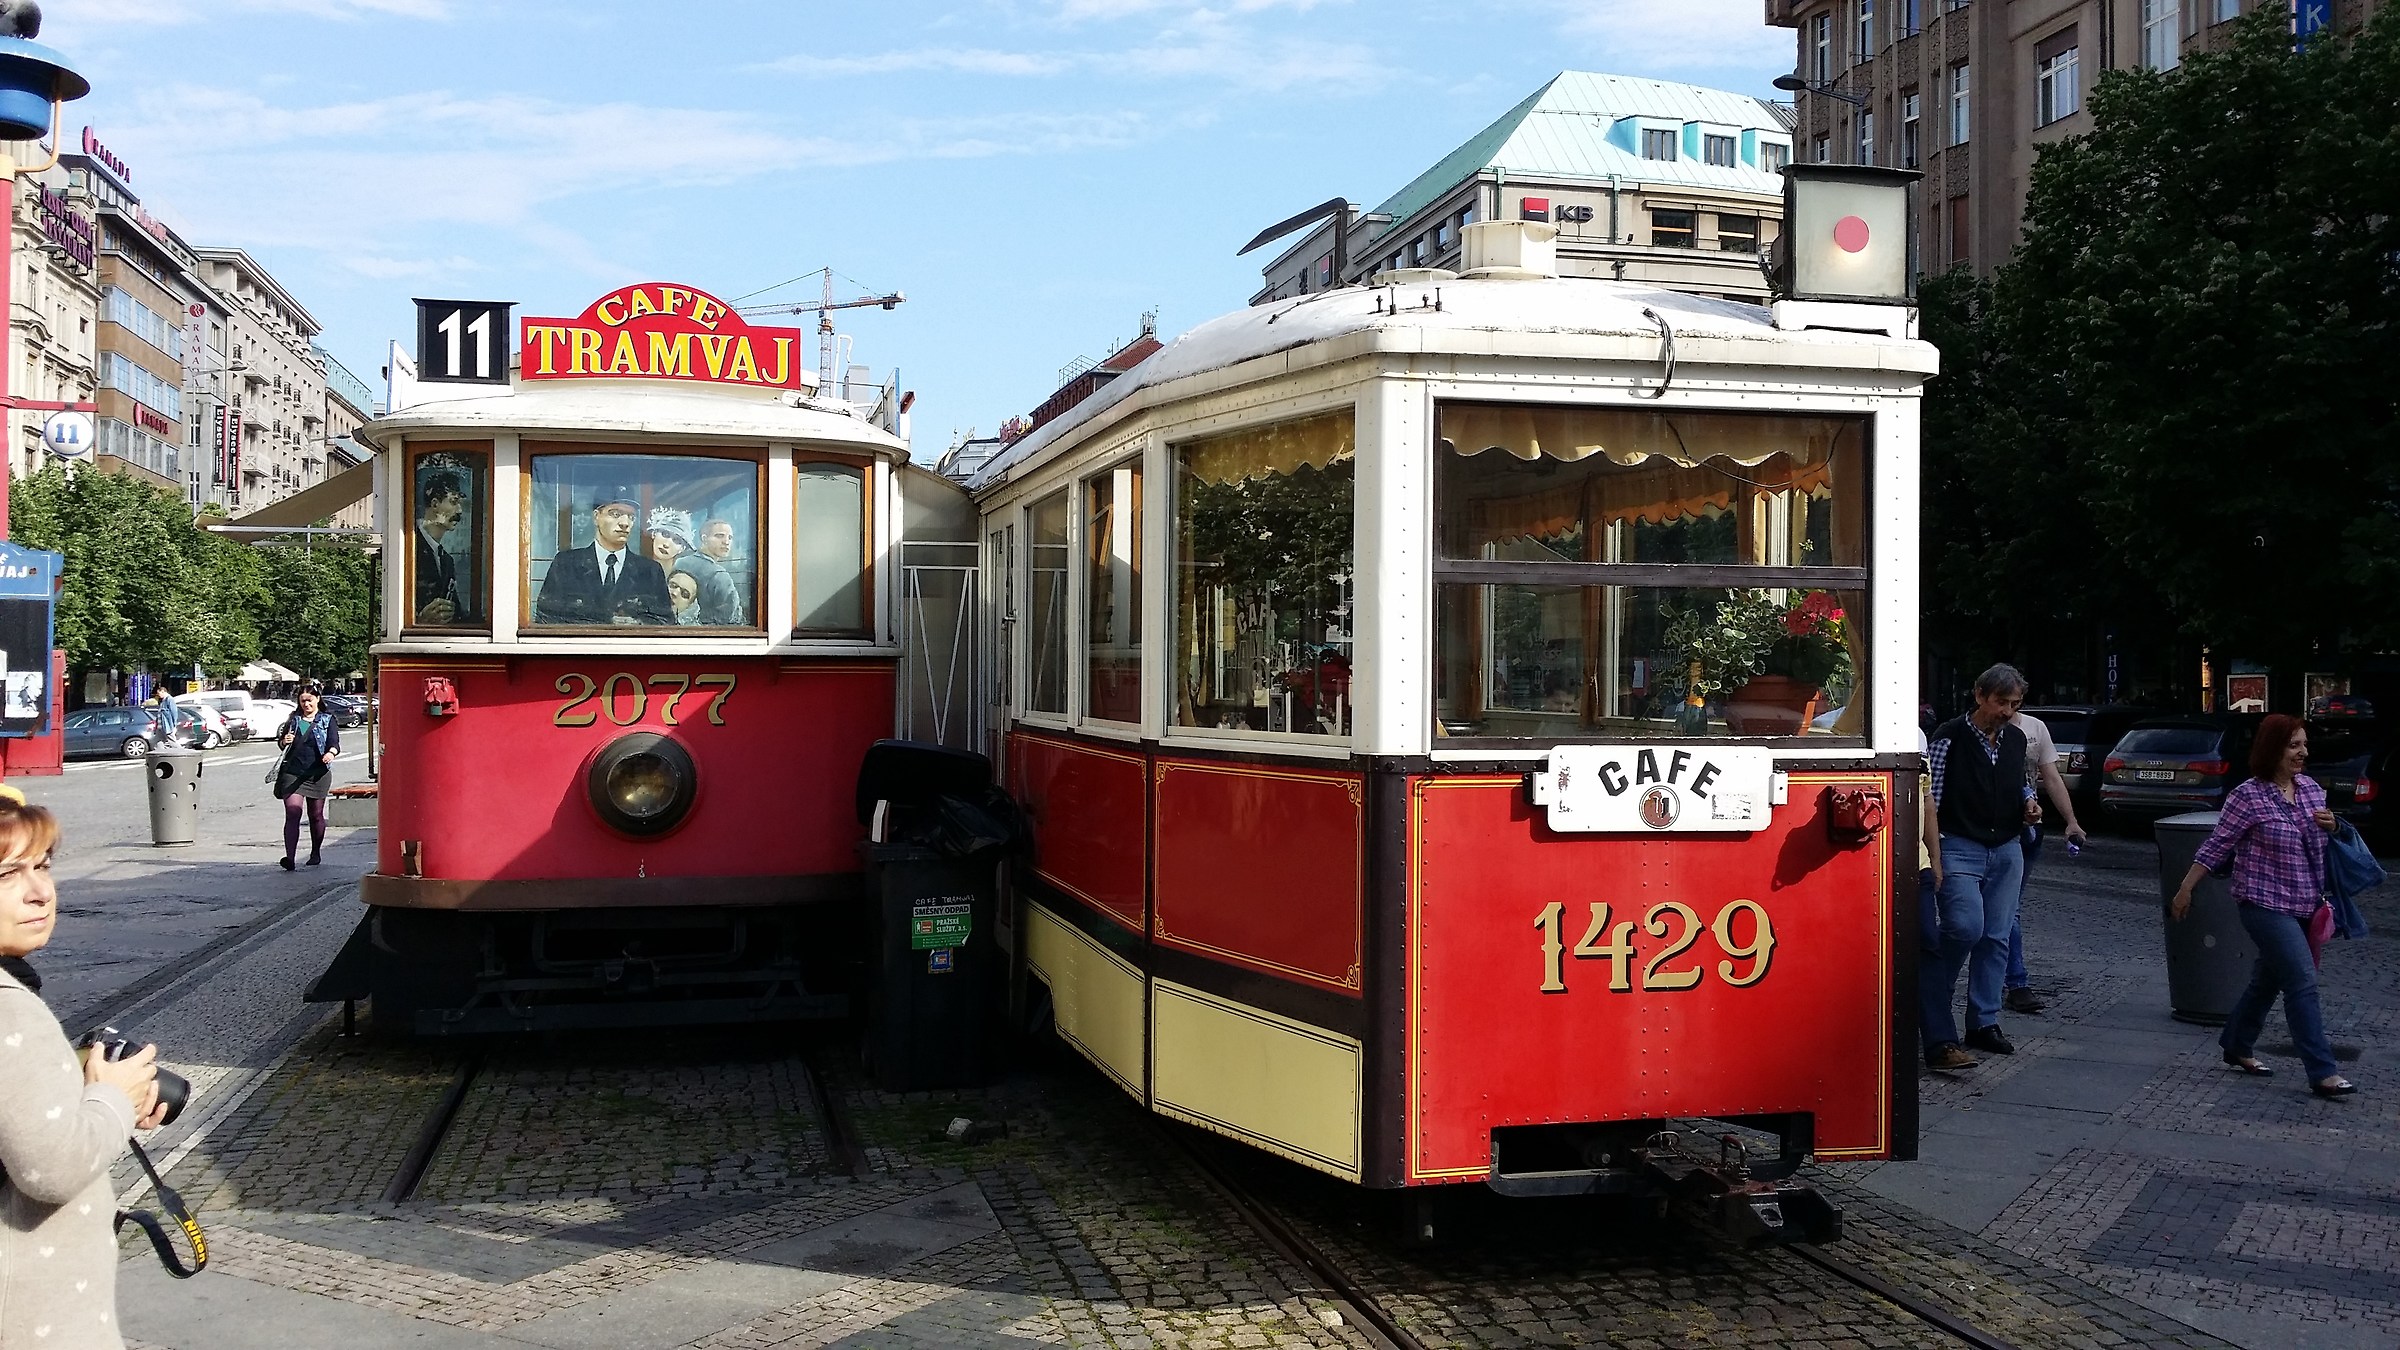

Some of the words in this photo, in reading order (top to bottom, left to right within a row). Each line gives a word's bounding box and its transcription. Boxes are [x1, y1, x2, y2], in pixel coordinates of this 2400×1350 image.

[92, 138, 131, 184] RAMADA
[1555, 204, 1594, 223] KB
[596, 287, 728, 332] CAFE
[437, 308, 491, 379] 11
[526, 324, 795, 386] TRAMVAJ
[55, 422, 79, 444] 11
[552, 672, 737, 728] 2077
[1597, 748, 1722, 799] CAFE
[945, 905, 969, 915] ODPAD
[1534, 898, 1778, 993] 1429
[183, 1219, 206, 1263] Nikon
